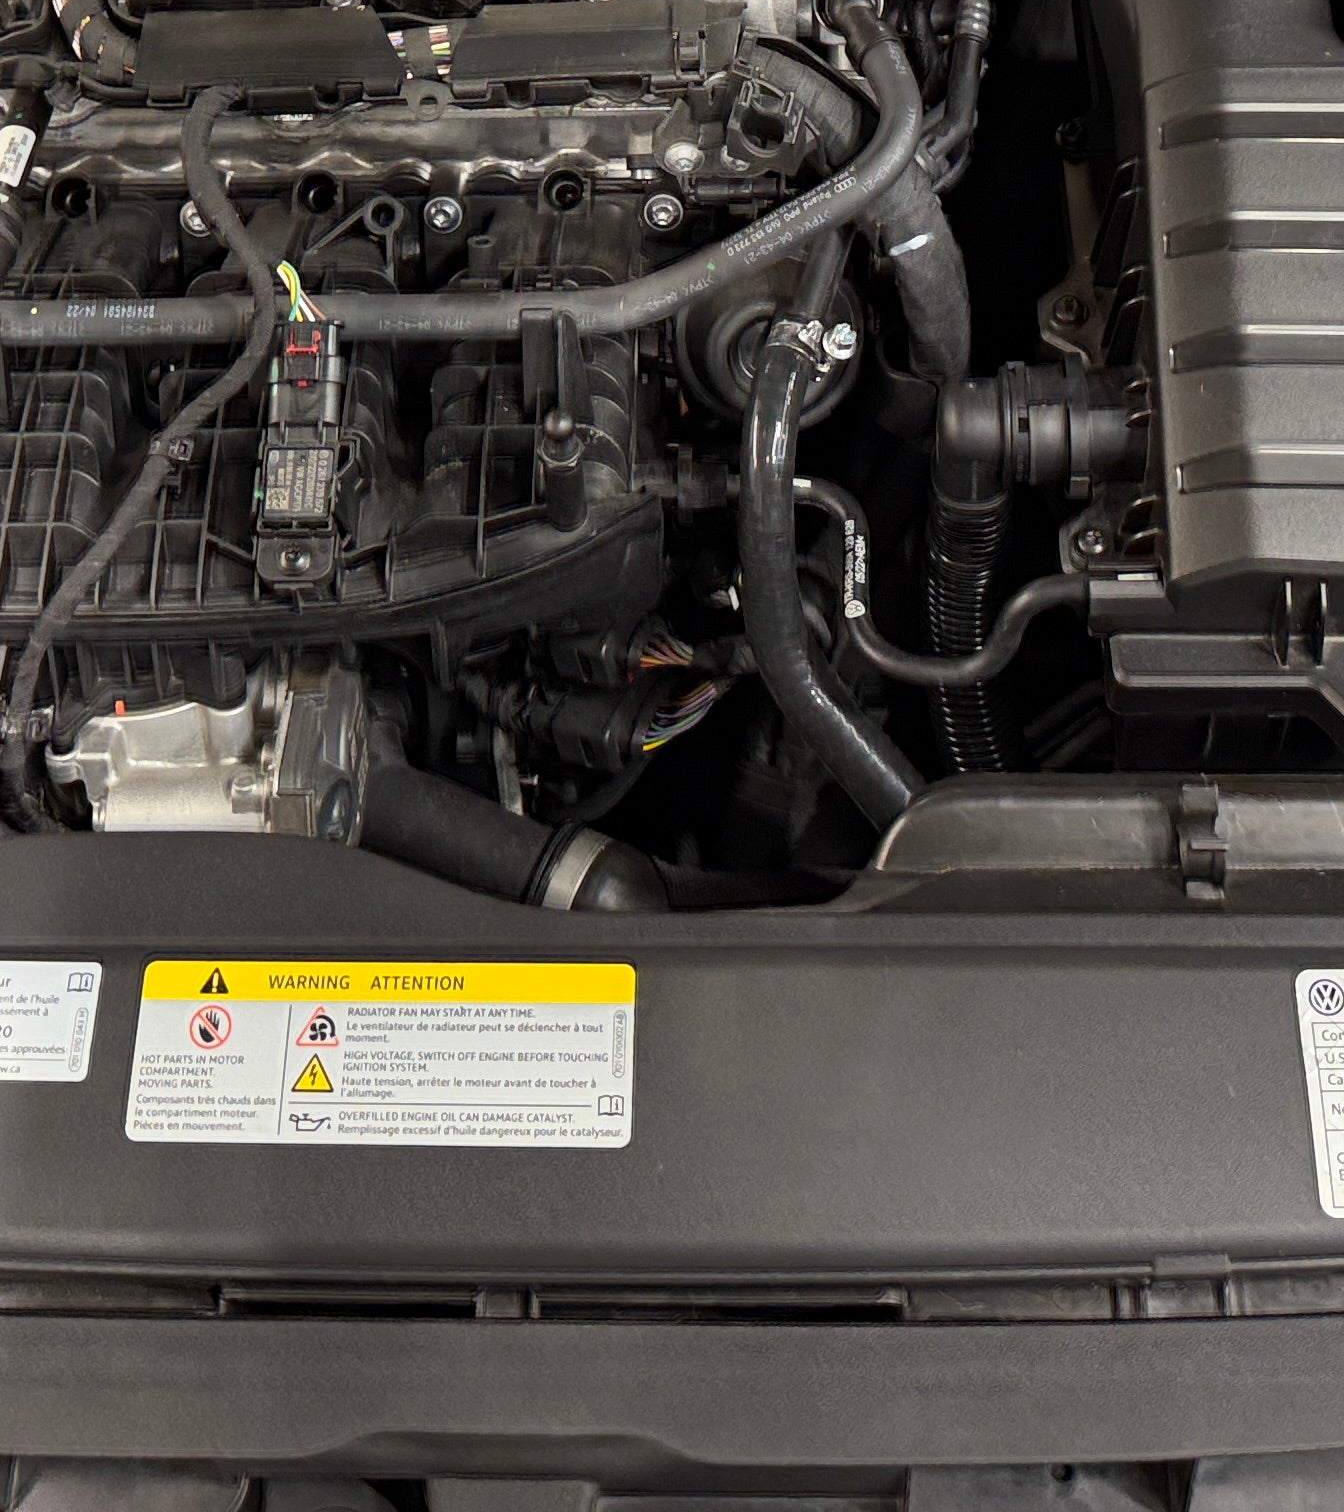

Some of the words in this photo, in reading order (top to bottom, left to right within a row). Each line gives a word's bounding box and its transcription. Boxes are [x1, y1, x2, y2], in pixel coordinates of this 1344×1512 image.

[269, 975, 350, 989] WARNING
[371, 976, 464, 990] ATTENTION
[348, 1008, 396, 1016] RADIATOR
[399, 1008, 417, 1017] FAN
[421, 1008, 441, 1017] MAY
[443, 1006, 472, 1017] START
[474, 1008, 486, 1017] AT
[488, 1009, 508, 1017] ANY
[510, 1009, 535, 1018] TIME.
[347, 1021, 358, 1031] Le
[417, 1023, 428, 1031] de
[431, 1022, 476, 1031] radiateur
[479, 1024, 501, 1033] peut
[518, 1023, 571, 1032] déclencher
[574, 1023, 579, 1032] à
[582, 1024, 603, 1032] tout
[141, 1055, 161, 1063] HOT
[164, 1055, 193, 1064] PARTS
[196, 1056, 206, 1064] IN
[209, 1056, 244, 1064] MOTOR
[344, 1051, 368, 1060] HIGH
[370, 1051, 415, 1060] VOLTAGE,
[418, 1052, 455, 1060] SWITCH
[458, 1052, 476, 1061] OFF
[479, 1052, 514, 1061] ENGINE
[518, 1053, 554, 1062] BEFORE
[558, 1053, 608, 1062] TOUCHING
[140, 1067, 215, 1076] COMPARTMENT.
[343, 1062, 386, 1071] IGNITION
[390, 1063, 428, 1072] SYSTEM.
[138, 1079, 177, 1088] MOVING
[181, 1079, 213, 1088] PARTS.
[342, 1077, 371, 1085] Haute
[375, 1078, 413, 1087] tension,
[417, 1078, 450, 1086] arrêter
[454, 1077, 462, 1087] le
[535, 1078, 547, 1088] de
[550, 1080, 588, 1088] toucher
[591, 1078, 596, 1088] à
[341, 1088, 394, 1099] l'allumage.
[339, 1112, 398, 1121] OVERFILLED
[401, 1112, 437, 1121] ENGINE
[441, 1112, 456, 1122] OIL
[459, 1113, 479, 1122] CAN
[482, 1113, 523, 1122] DAMAGE
[527, 1113, 573, 1123] CATALYST.
[338, 1124, 400, 1135] Remplissage
[403, 1126, 441, 1134] excessif
[444, 1125, 477, 1135] d'huile
[479, 1128, 531, 1137] dangereux
[534, 1129, 556, 1138] pour
[559, 1127, 568, 1136] le
[571, 1129, 623, 1137] catalyseur.
